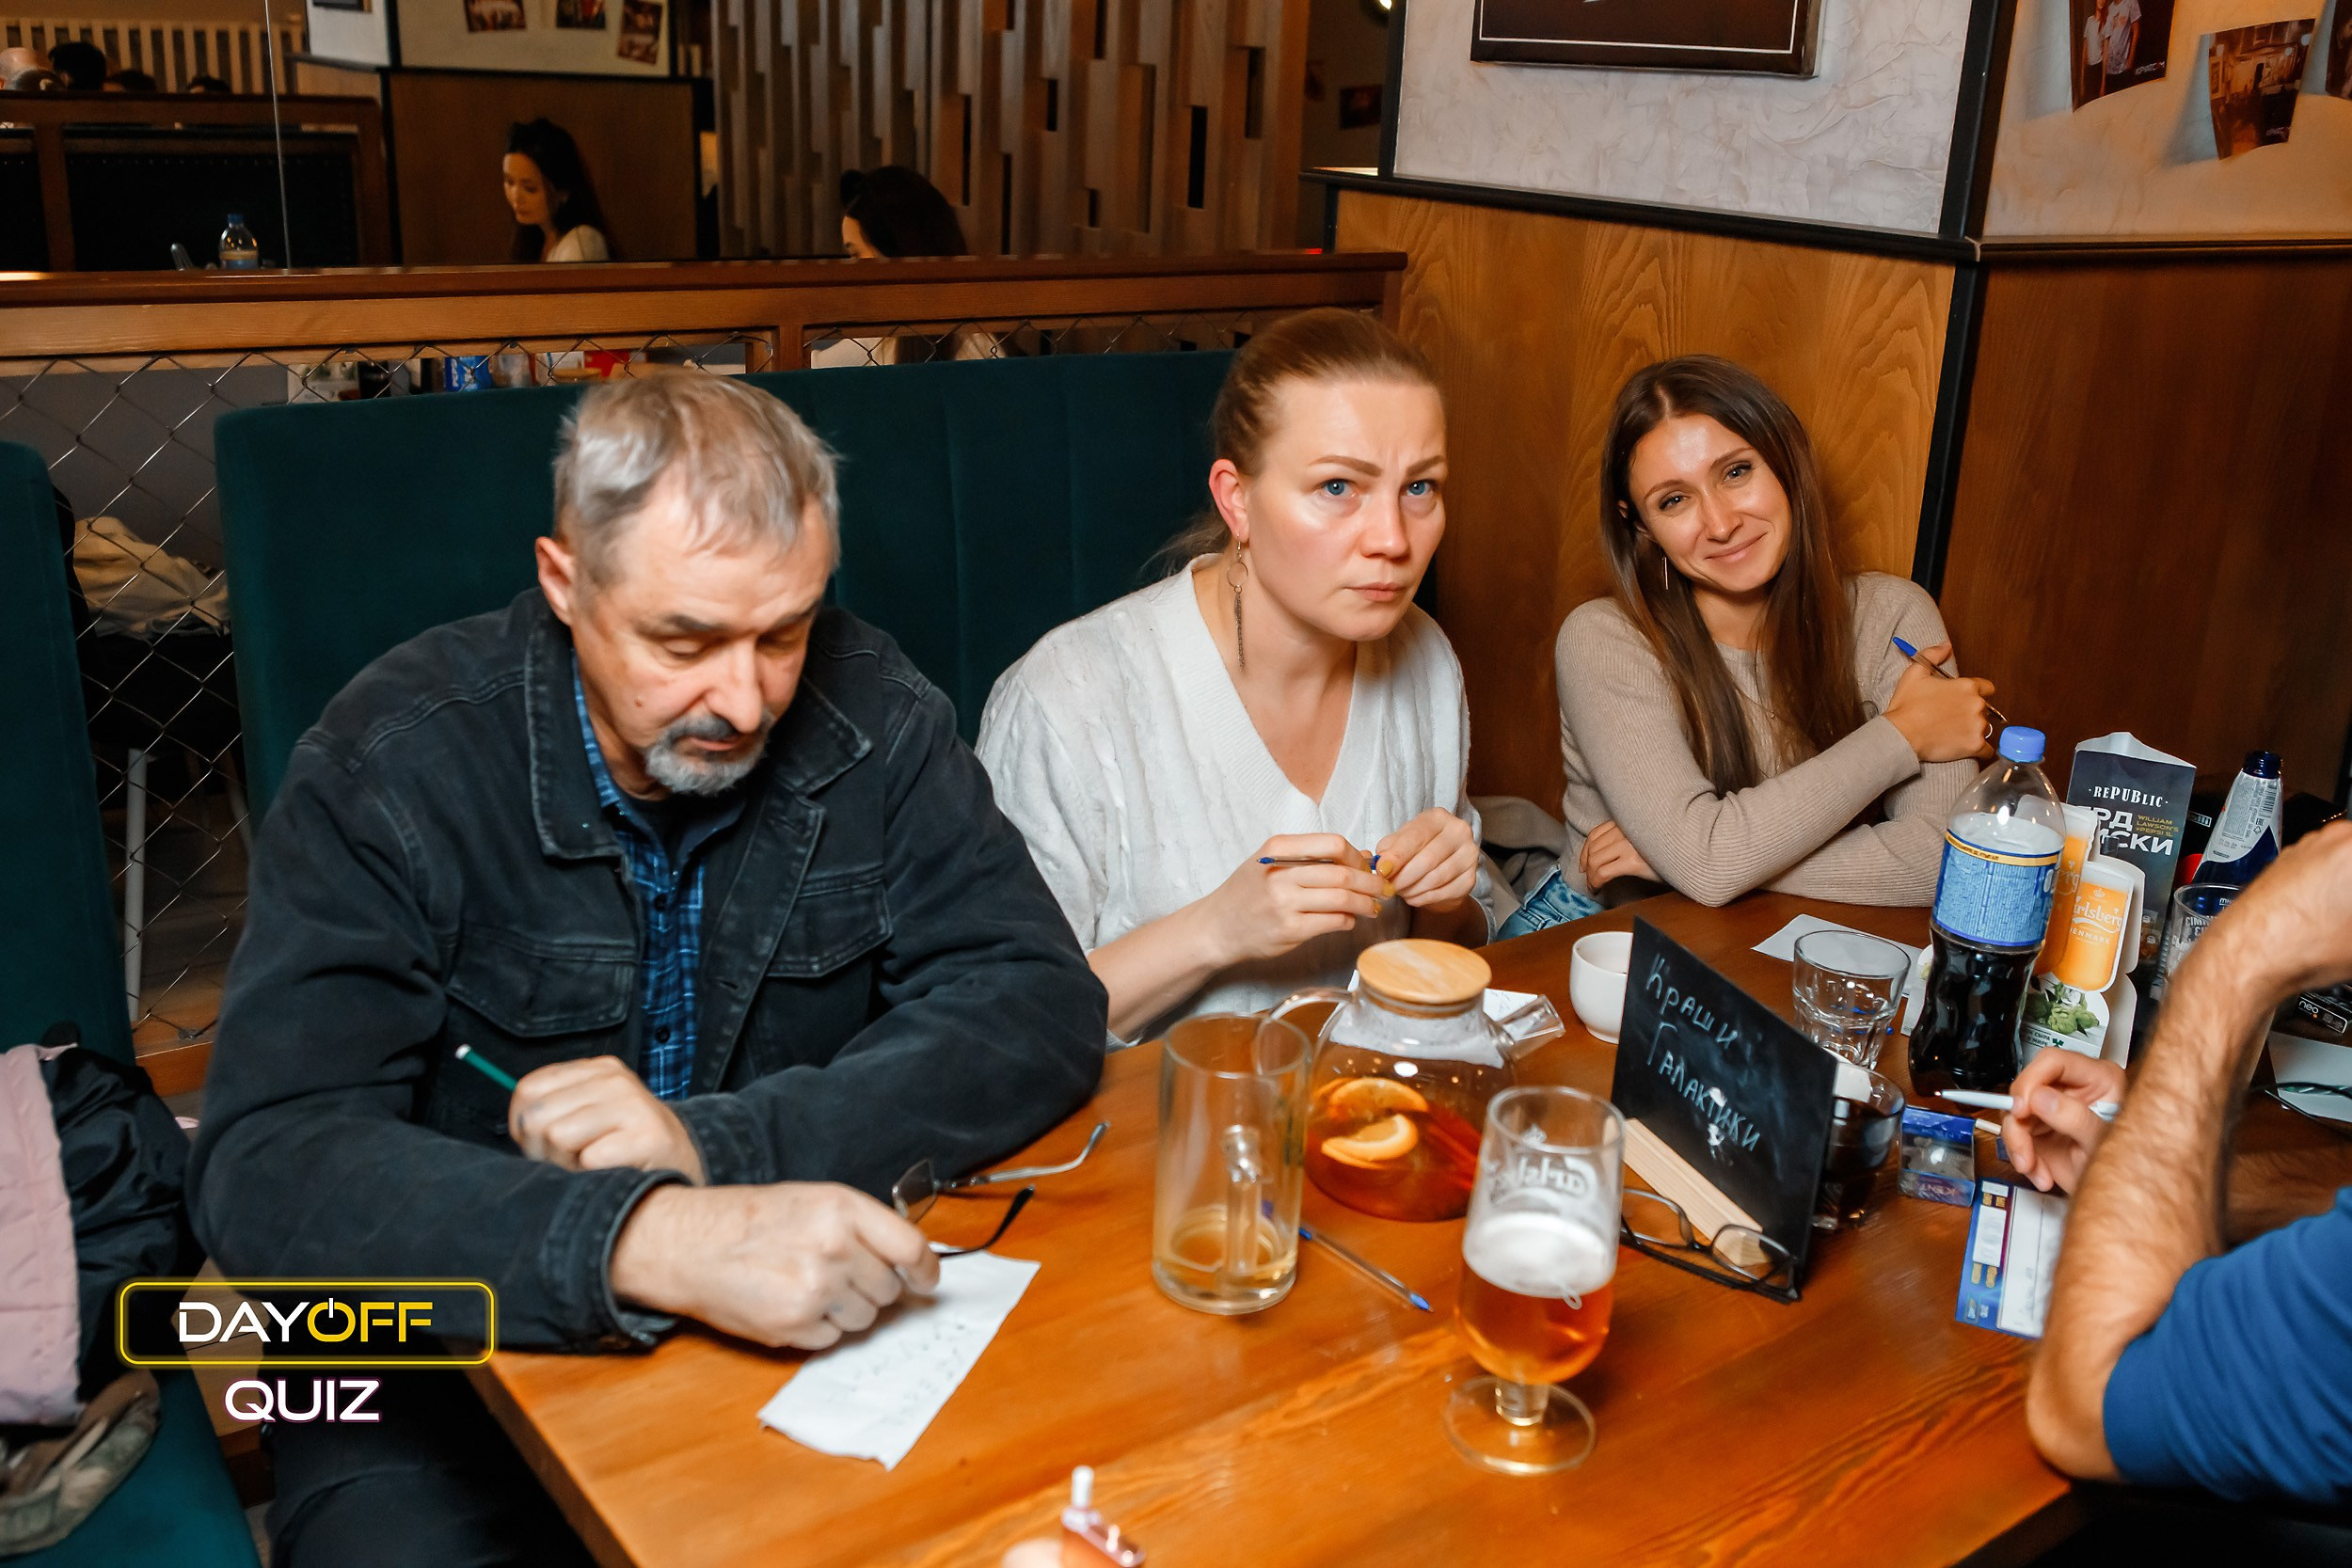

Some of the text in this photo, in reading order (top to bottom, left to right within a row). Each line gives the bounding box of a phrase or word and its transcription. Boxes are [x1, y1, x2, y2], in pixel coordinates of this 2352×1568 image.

[2137, 815, 2173, 825] WILLIAM
[2137, 820, 2179, 832] LAWSON'S
[2070, 927, 2110, 944] ENMARK
[2298, 1000, 2319, 1014] neo
